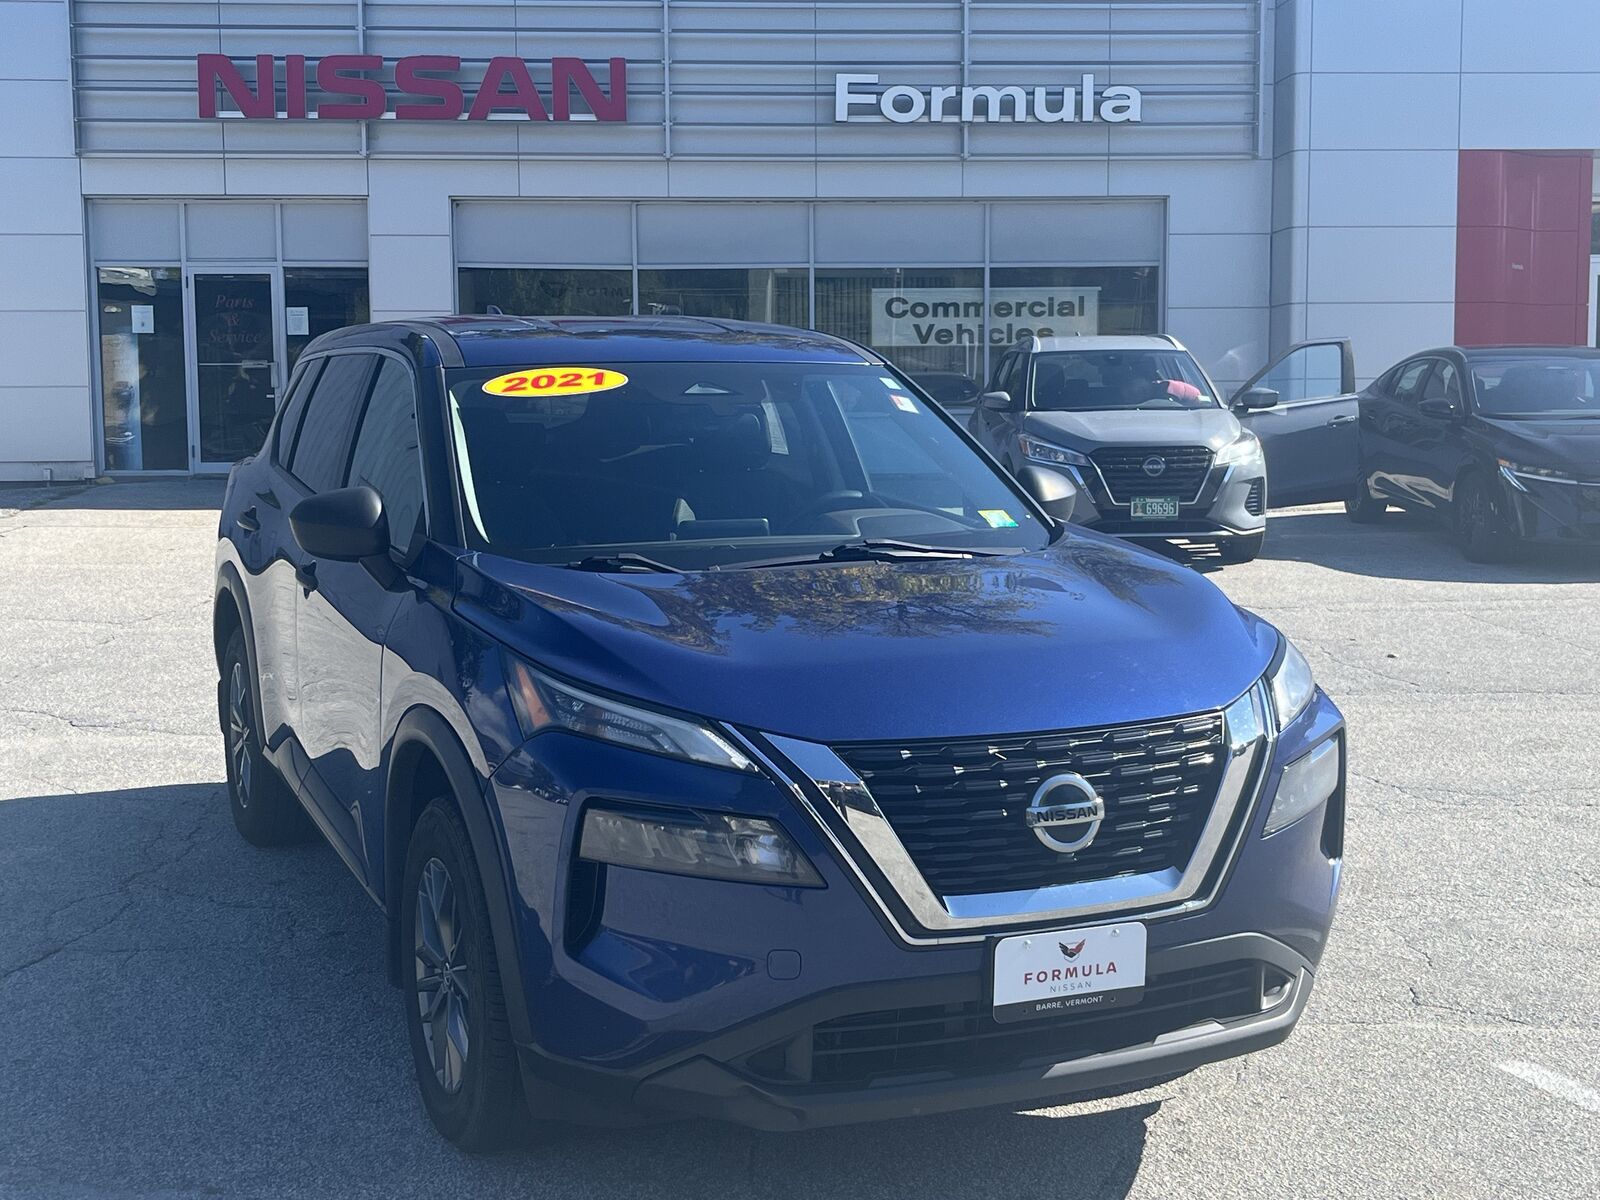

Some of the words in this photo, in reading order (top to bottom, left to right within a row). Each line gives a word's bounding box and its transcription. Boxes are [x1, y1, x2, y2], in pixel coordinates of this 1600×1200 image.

[197, 54, 628, 122] NISSAN
[834, 73, 1142, 123] Formula
[216, 294, 255, 309] Parts
[885, 296, 1085, 319] Commercial
[502, 372, 606, 393] 2021
[1146, 502, 1174, 514] 69696
[1037, 806, 1098, 822] NISSAN
[1024, 961, 1117, 985] FORMULA
[1049, 981, 1092, 993] NISSAN
[1035, 1001, 1064, 1012] BARRE,
[1065, 995, 1104, 1007] VERMONT
